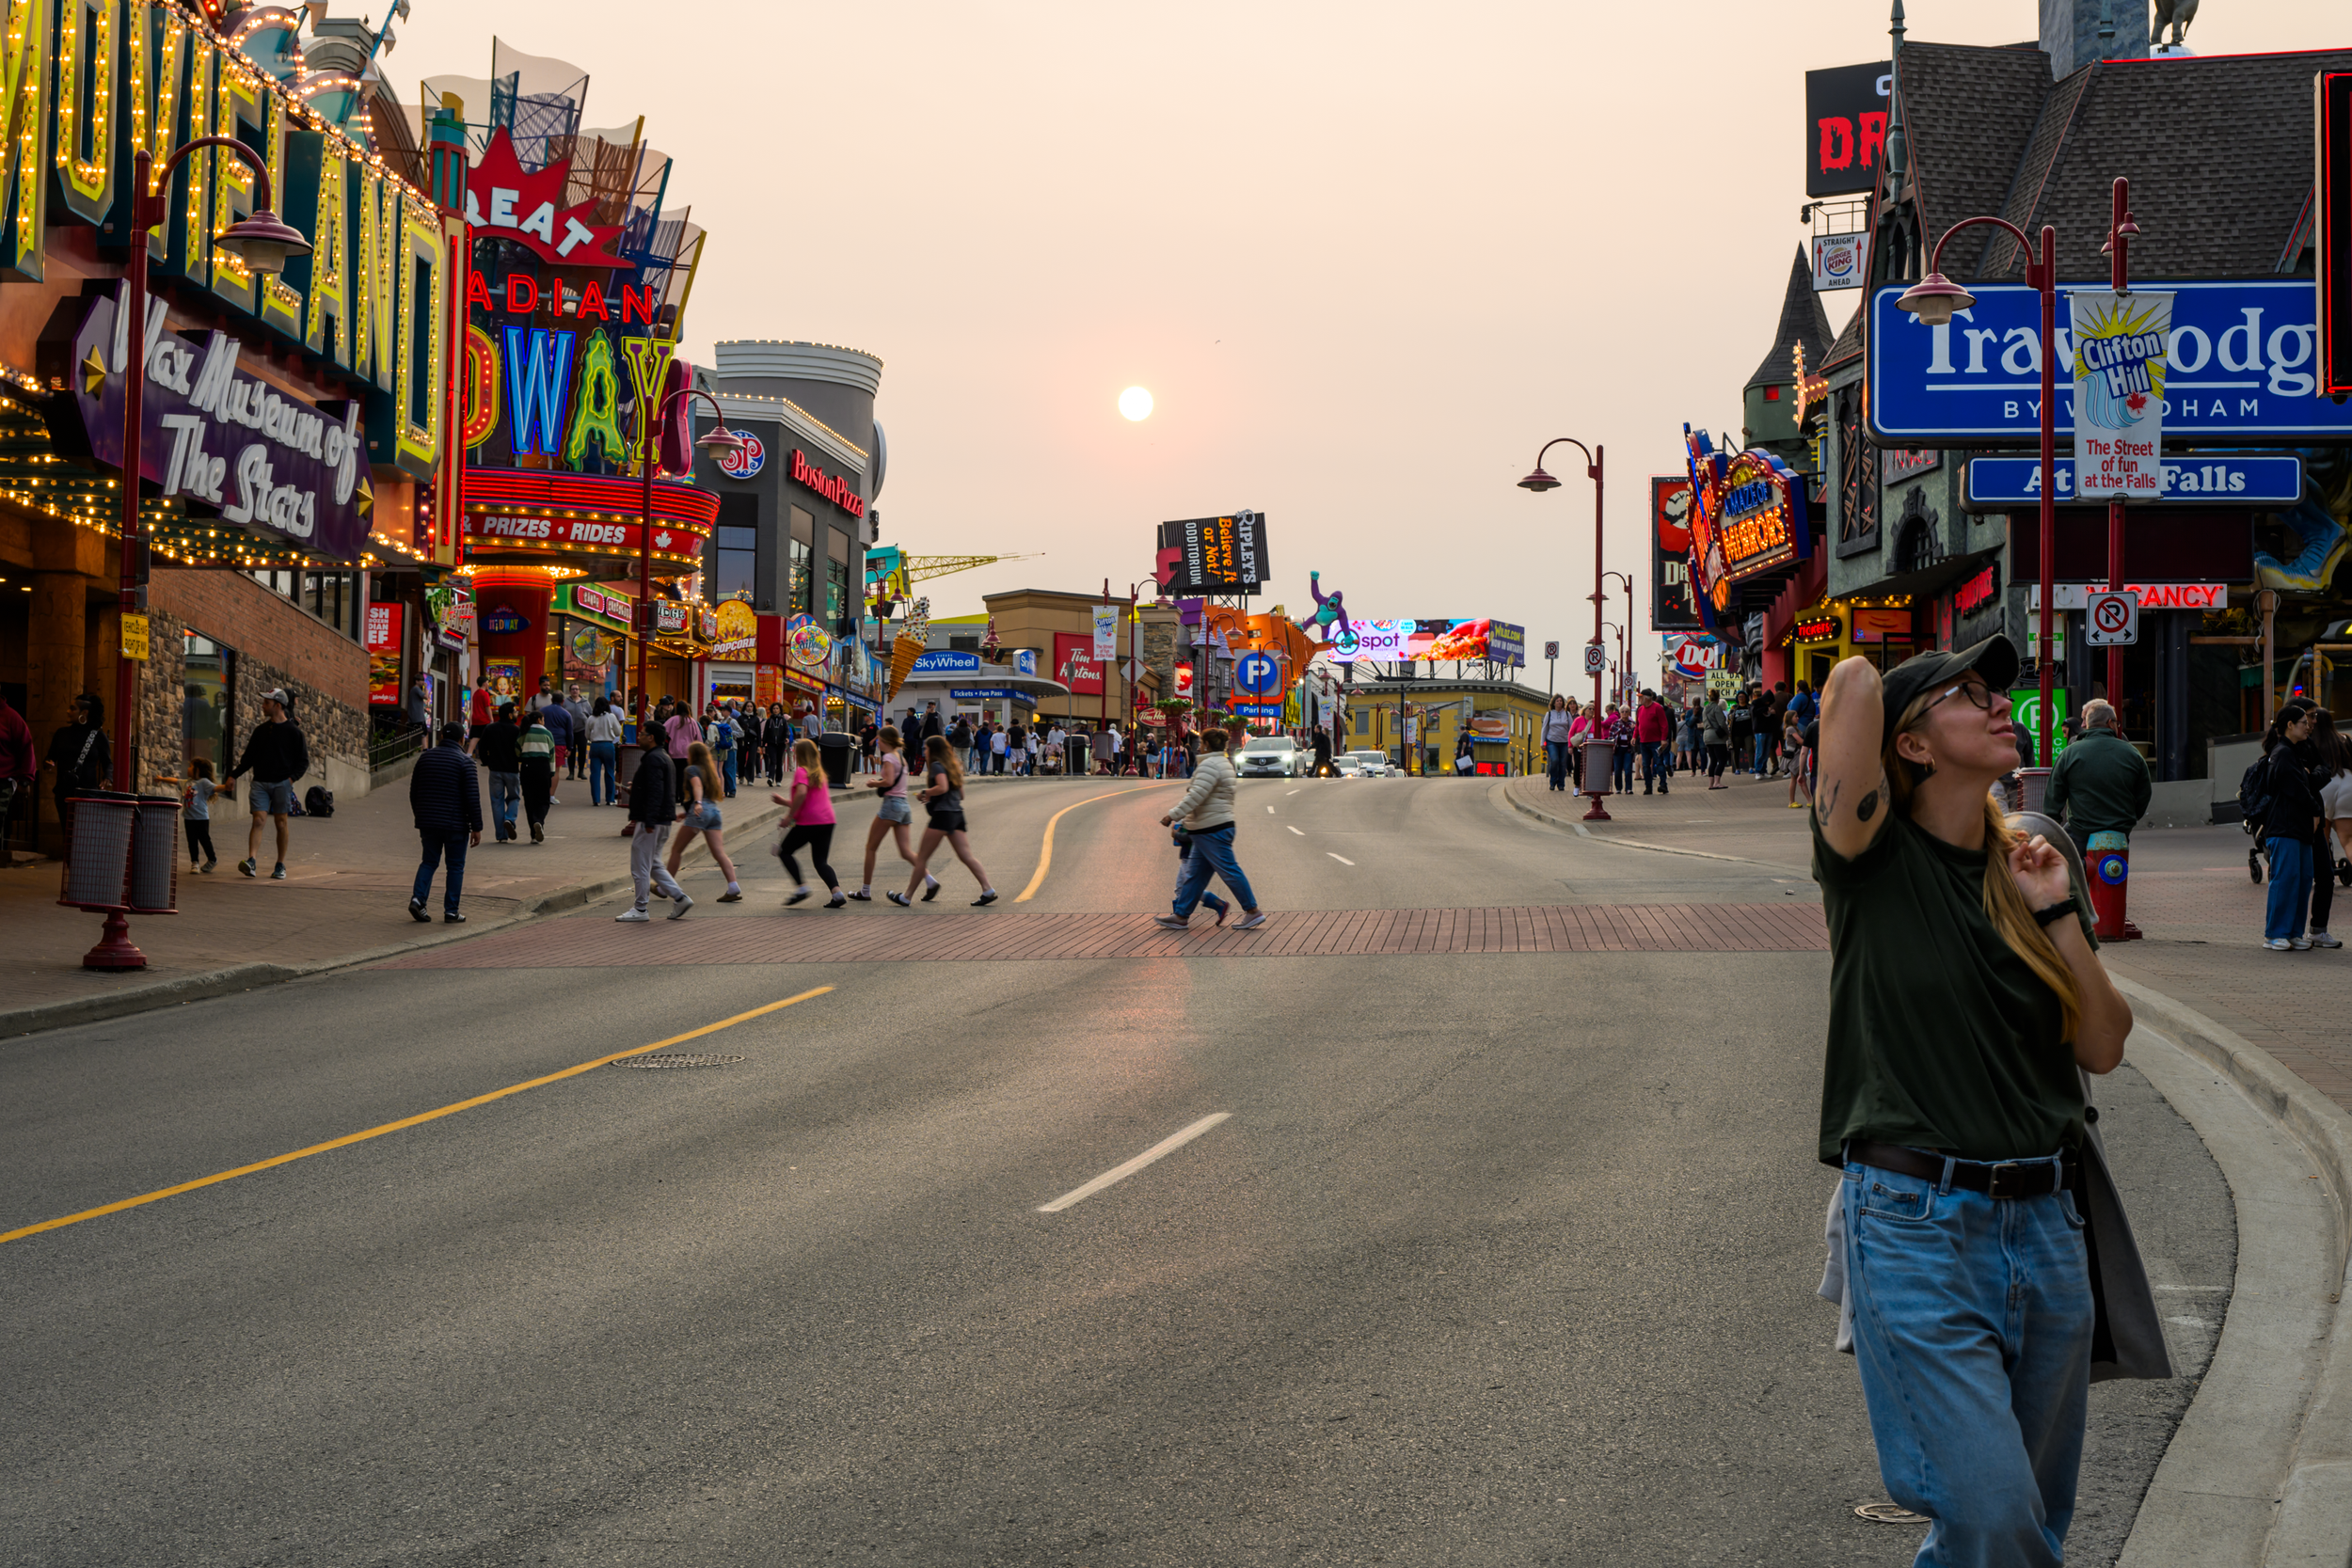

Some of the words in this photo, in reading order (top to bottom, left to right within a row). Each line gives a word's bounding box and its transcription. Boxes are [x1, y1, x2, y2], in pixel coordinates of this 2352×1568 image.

[1823, 237, 1855, 247] STRAIGHT
[1827, 250, 1852, 264] BURGER
[1828, 258, 1852, 272] KING
[1828, 278, 1851, 287] AHEAD
[1908, 307, 2317, 397] Traodg
[2082, 332, 2162, 371] Clifton
[2106, 362, 2152, 399] Hill
[112, 277, 196, 395] Wax
[188, 331, 324, 460] Museum
[324, 402, 360, 505] of
[2004, 401, 2042, 419] BY
[2086, 439, 2111, 455] The
[2114, 438, 2153, 456] Street
[2101, 456, 2115, 472] of
[2118, 456, 2138, 473] fun
[161, 414, 227, 503] The
[222, 444, 316, 538] Stars
[790, 449, 836, 502] Boston
[834, 475, 865, 518] Pizza
[2023, 466, 2072, 492] At
[2163, 465, 2246, 493] Falls
[2085, 474, 2098, 488] at
[2101, 473, 2123, 488] the
[2126, 473, 2156, 489] Falls
[483, 516, 551, 538] PRIZES
[569, 522, 627, 544] RIDES
[1203, 527, 1215, 544] or
[1722, 505, 1786, 564] MIRRORS
[1218, 517, 1234, 567] Believe
[1235, 509, 1257, 584] RIPLEY'S
[1185, 522, 1202, 585] ODDITORIUM
[1204, 545, 1221, 576] Not!
[1223, 569, 1237, 583] It
[2086, 585, 2223, 608] CANCY
[1094, 616, 1117, 627] Clifton
[1101, 624, 1114, 635] Hill
[1798, 622, 1834, 637] TICKETS
[713, 637, 756, 655] POPCORN
[1361, 632, 1400, 651] spot
[914, 657, 976, 670] SkyWheel
[1071, 648, 1090, 664] Tim
[1682, 644, 1714, 668] DQ
[1059, 662, 1100, 680] Hrtons
[1243, 706, 1275, 721] Paring
